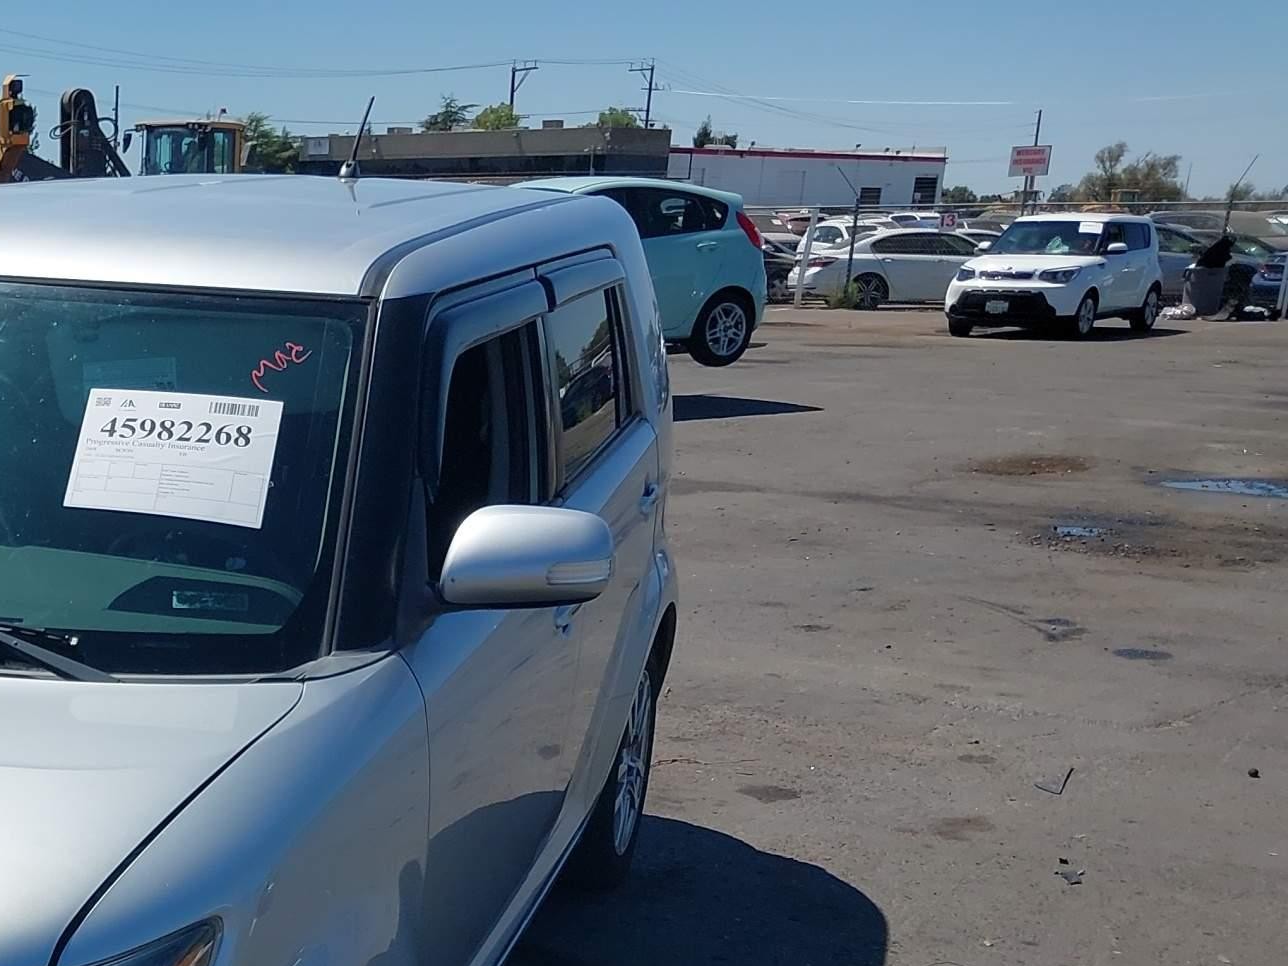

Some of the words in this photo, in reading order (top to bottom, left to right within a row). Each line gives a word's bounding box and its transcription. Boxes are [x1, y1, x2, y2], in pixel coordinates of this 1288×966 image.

[940, 214, 956, 228] 13
[99, 416, 252, 448] 45982268
[85, 437, 131, 447] Progressive
[132, 440, 165, 450] Casualty
[167, 442, 206, 452] Insurance
